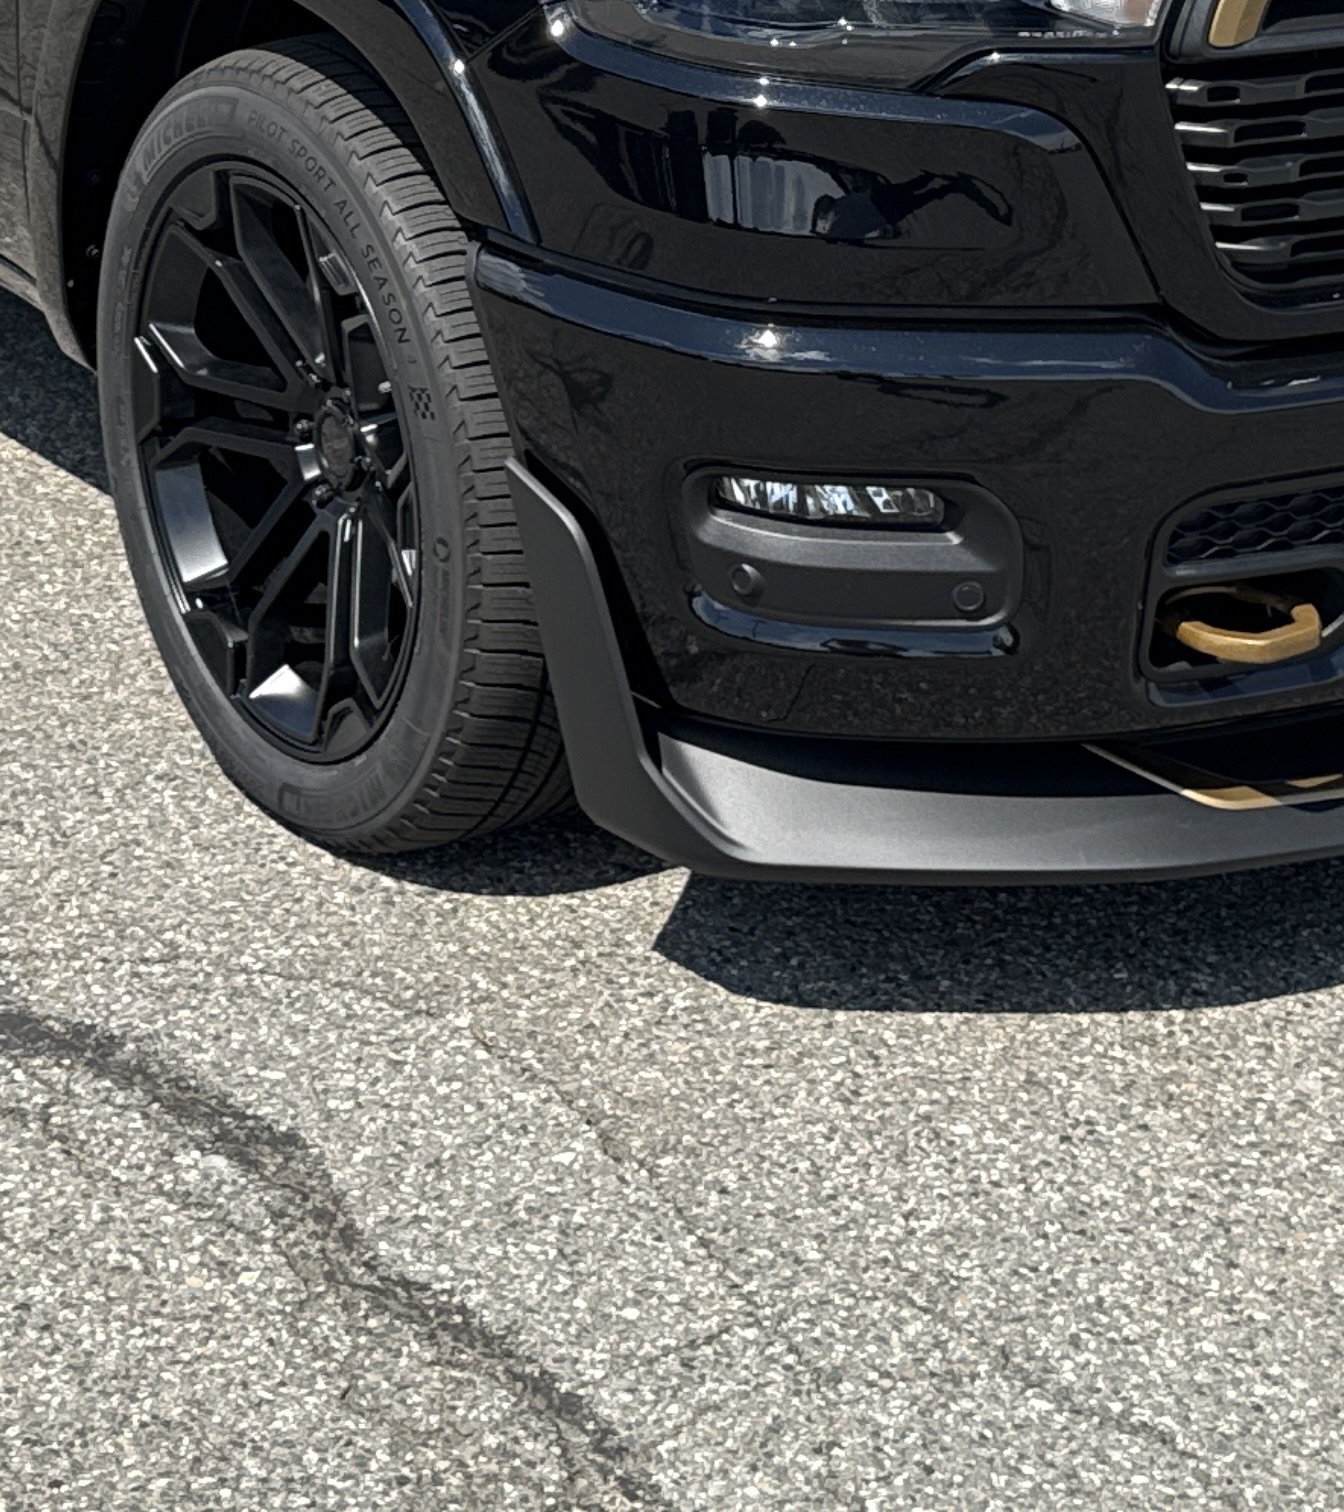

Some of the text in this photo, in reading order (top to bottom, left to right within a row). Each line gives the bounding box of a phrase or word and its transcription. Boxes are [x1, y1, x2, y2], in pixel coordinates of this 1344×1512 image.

[248, 109, 288, 139] PILOT
[289, 139, 337, 192] SPORT
[335, 199, 362, 239] ALL
[361, 243, 411, 345] SEASON
